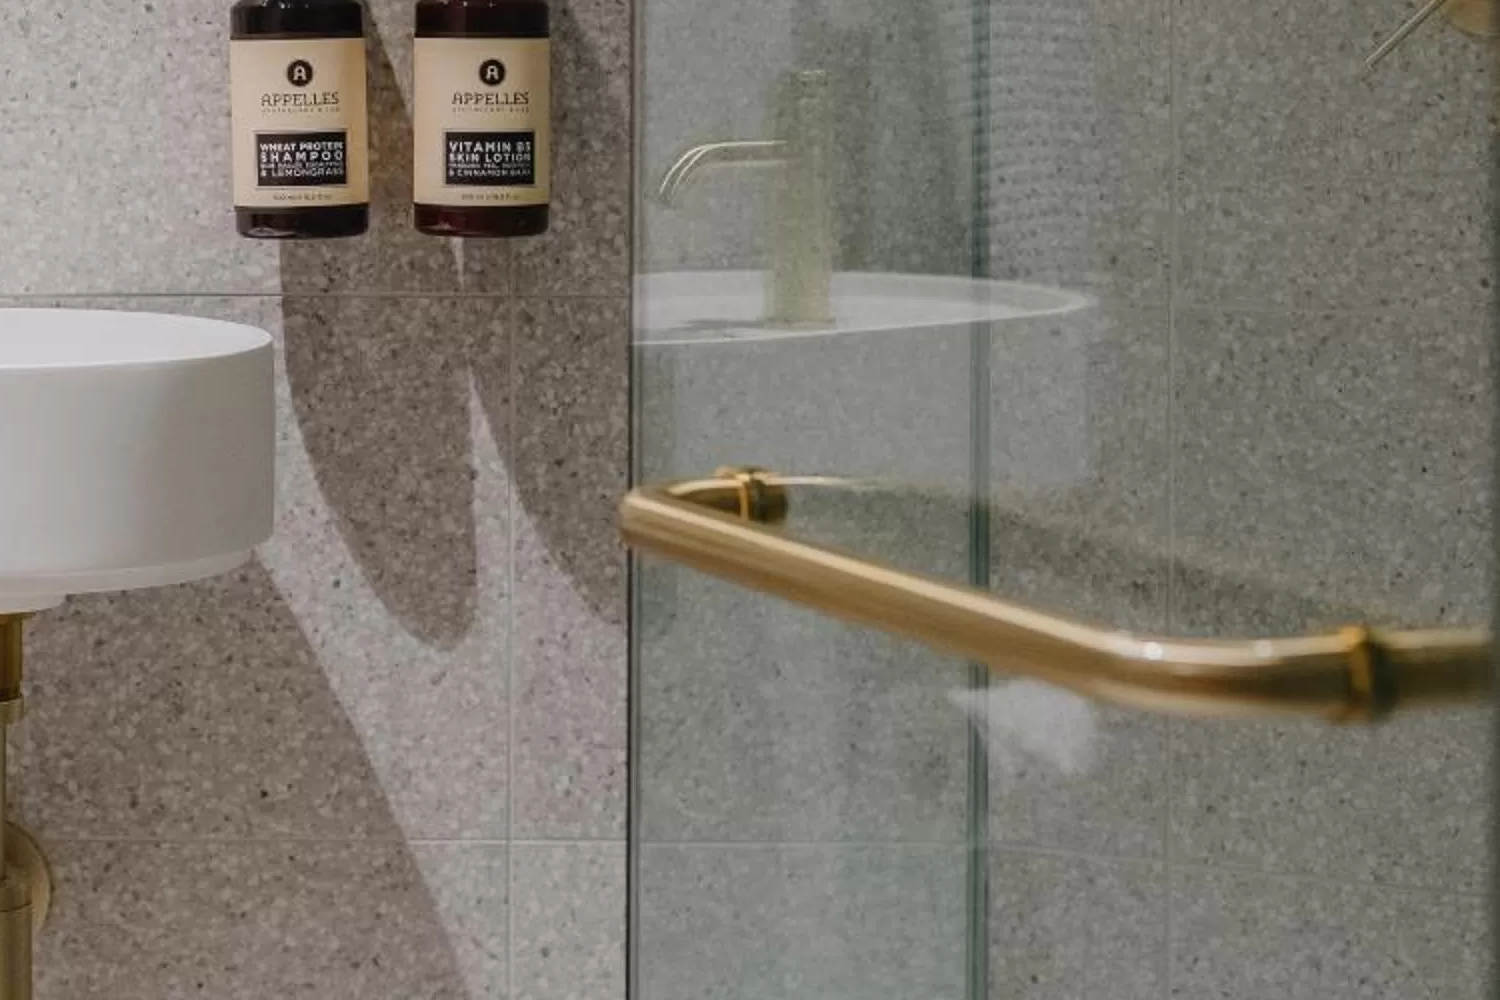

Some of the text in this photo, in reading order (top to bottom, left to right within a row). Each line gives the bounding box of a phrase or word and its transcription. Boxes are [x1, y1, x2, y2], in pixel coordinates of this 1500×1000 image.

[261, 92, 340, 106] APPELLES
[452, 92, 529, 105] APPELLES
[260, 141, 344, 152] WHEAT PROTEIN
[449, 141, 511, 152] VITAMIN
[259, 151, 343, 163] SHAMPOO
[449, 152, 531, 163] SKIN LOTION
